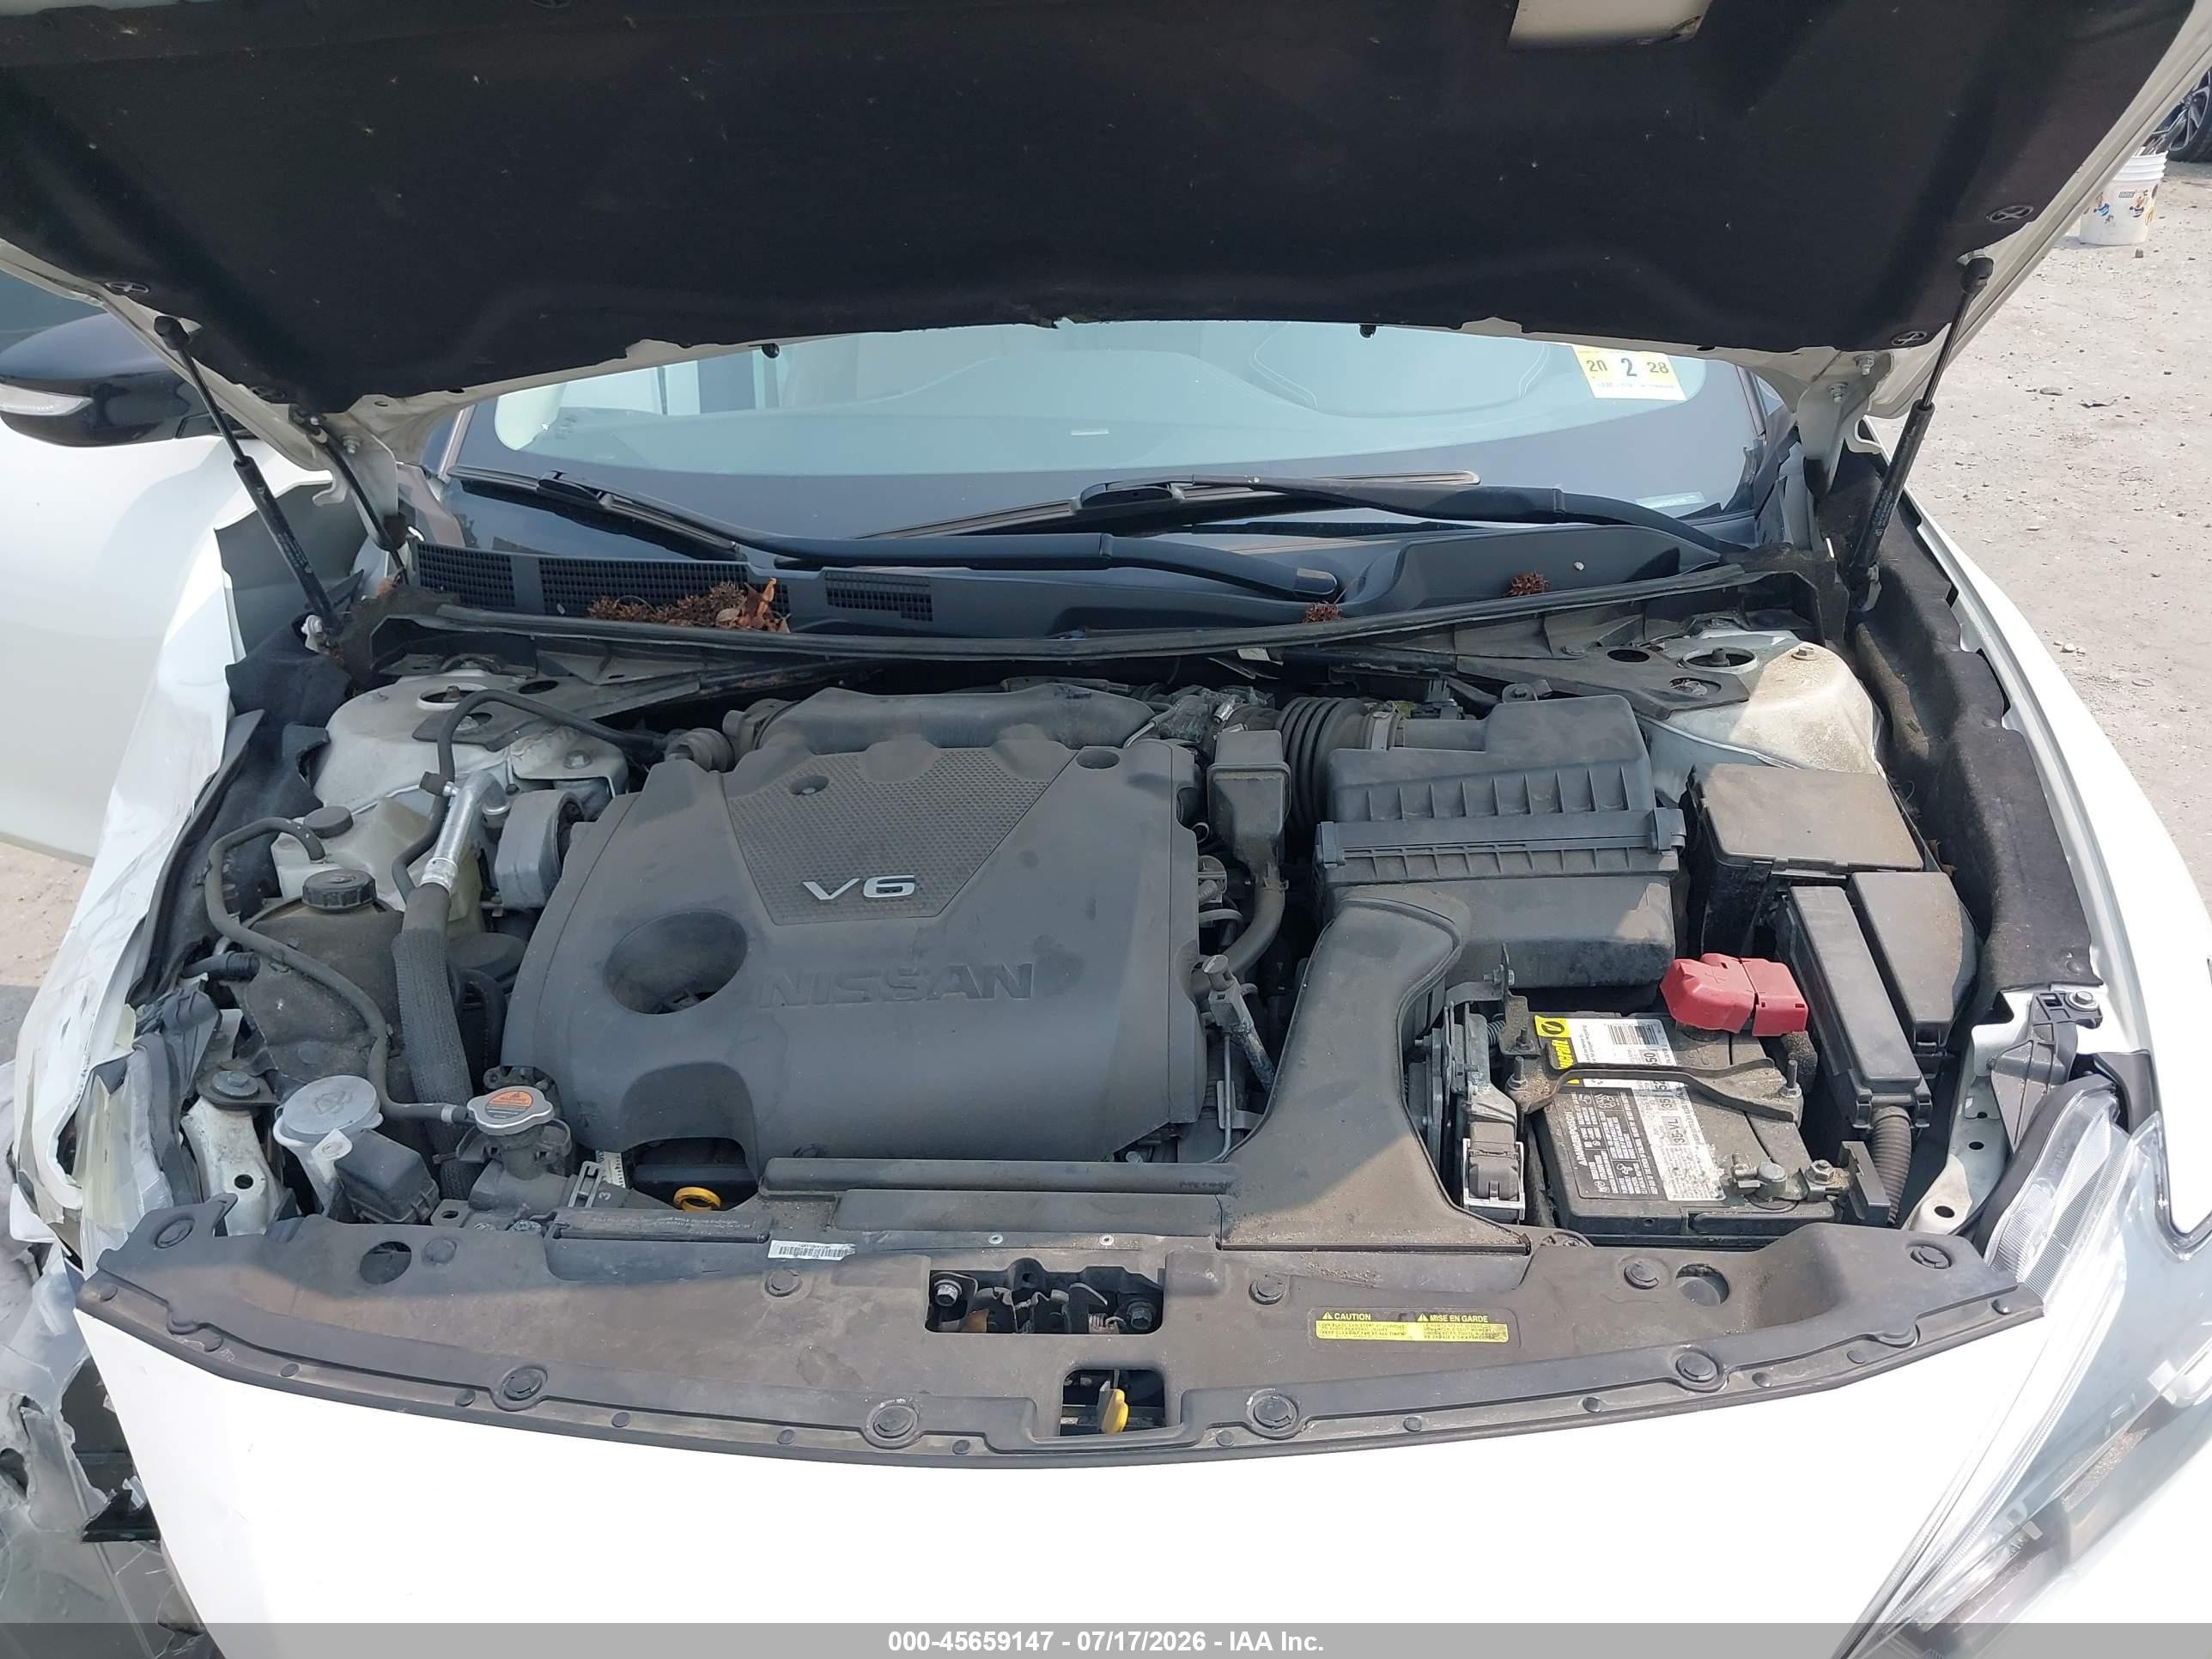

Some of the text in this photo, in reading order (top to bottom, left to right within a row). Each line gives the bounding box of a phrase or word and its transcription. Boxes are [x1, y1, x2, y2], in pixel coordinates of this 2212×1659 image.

[1620, 357, 1637, 377] 2
[1646, 362, 1668, 374] 28
[802, 874, 916, 900] V6
[759, 963, 1034, 1008] NISSAN
[1660, 1098, 1673, 1109] 35
[1668, 1118, 1686, 1144] 35-VL
[1334, 1313, 1371, 1322] CAUTION
[1430, 1314, 1449, 1322] MISE
[1462, 1315, 1489, 1323] GARDE
